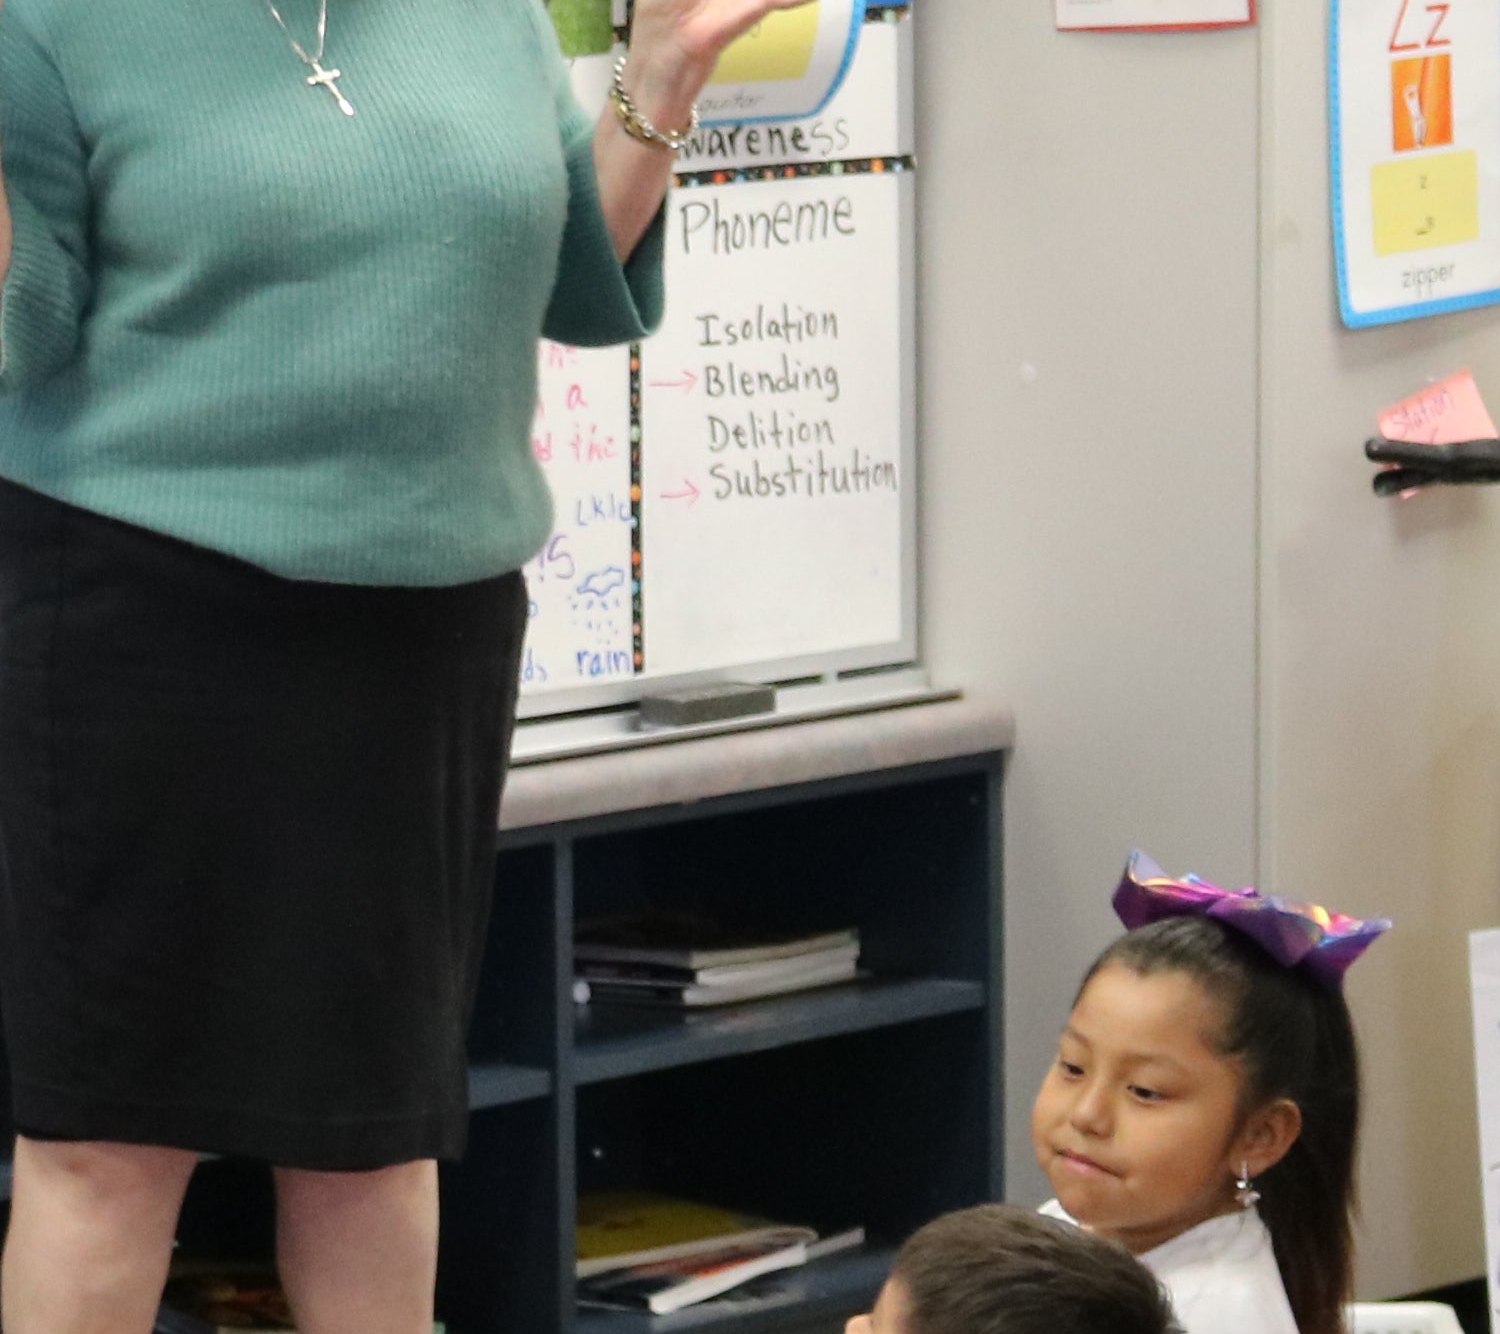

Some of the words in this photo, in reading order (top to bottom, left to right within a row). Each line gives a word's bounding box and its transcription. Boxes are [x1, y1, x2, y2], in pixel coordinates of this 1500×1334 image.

[680, 192, 857, 256] Phoneme
[1401, 261, 1458, 299] zipper
[695, 303, 839, 347] Isolation
[705, 362, 841, 403] Blending
[706, 411, 836, 453] Delition
[707, 448, 900, 501] Substitution
